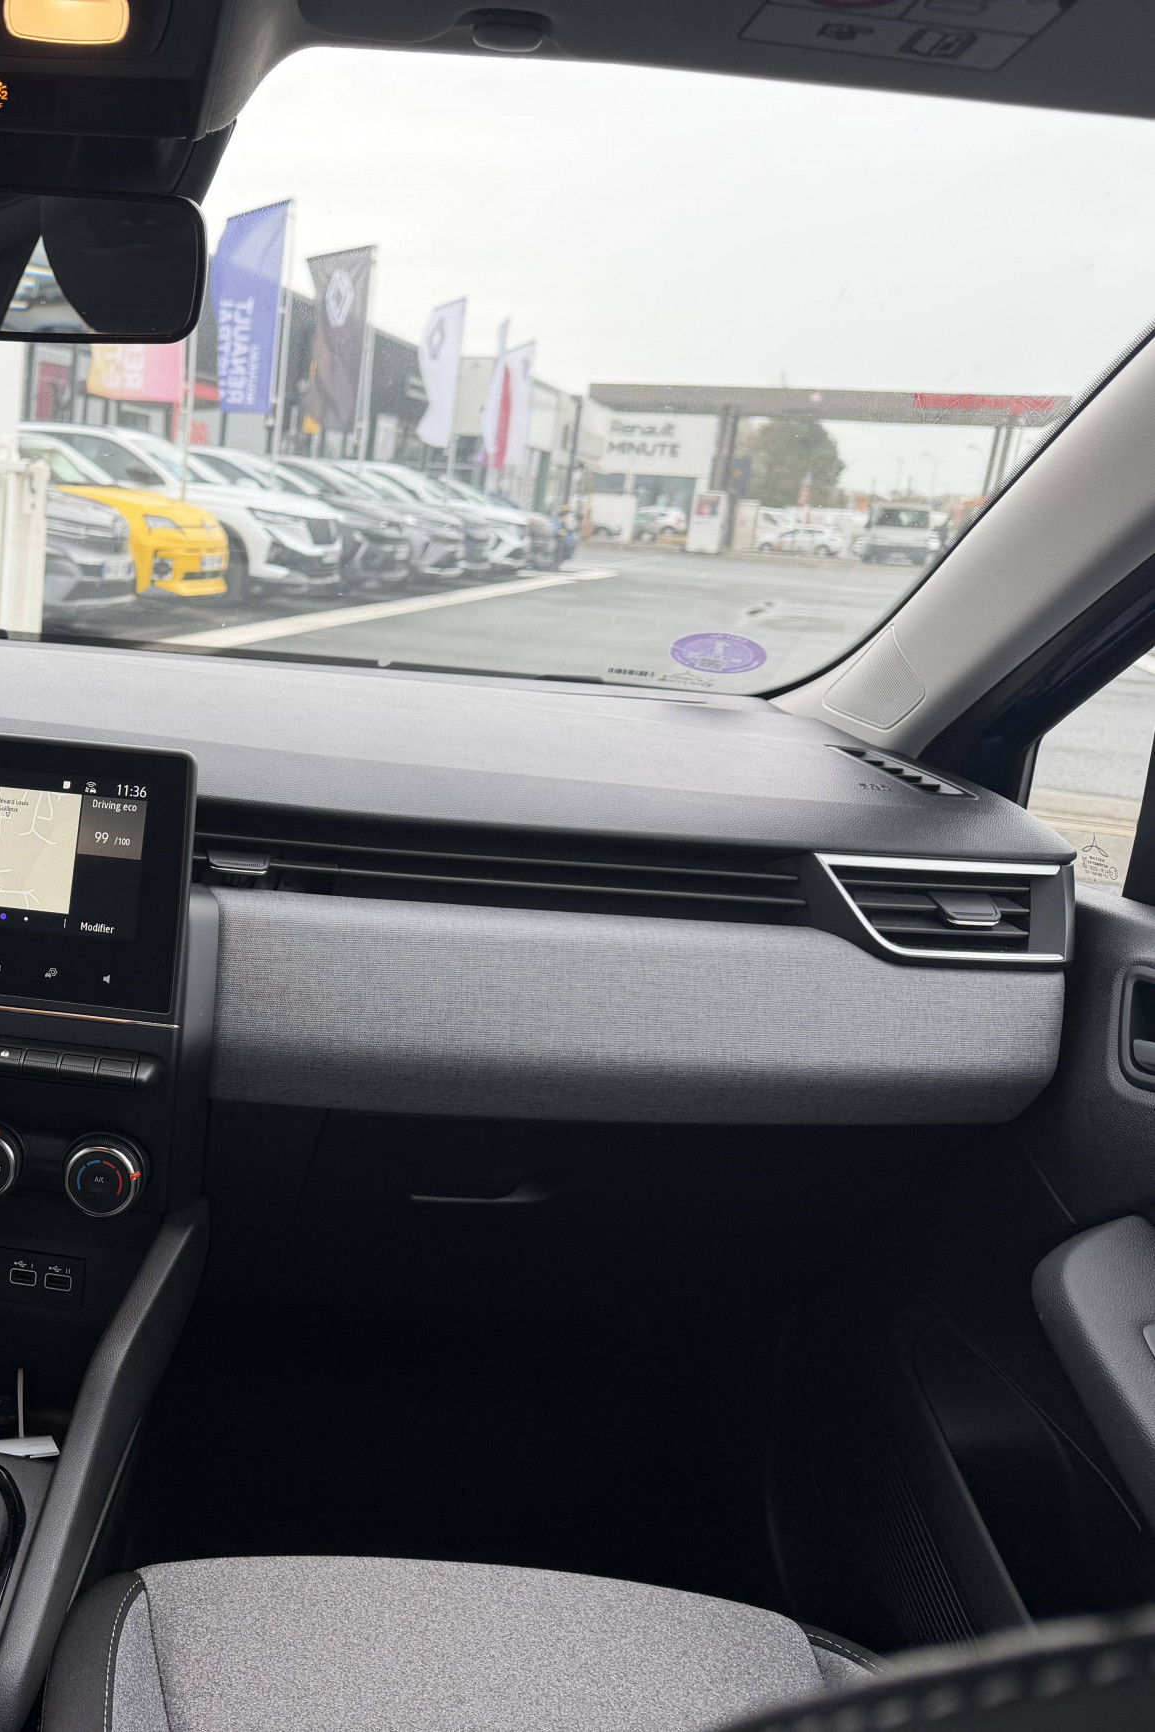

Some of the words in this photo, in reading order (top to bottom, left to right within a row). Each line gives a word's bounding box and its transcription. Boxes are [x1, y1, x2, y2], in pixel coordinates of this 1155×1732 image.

[610, 420, 675, 438] Renault
[607, 441, 680, 458] MINUTE
[116, 783, 147, 798] 11:36
[92, 798, 121, 813] Driving
[122, 803, 137, 812] eco
[94, 831, 110, 844] 99
[113, 836, 131, 846] /100
[80, 921, 115, 934] Modifier
[94, 1176, 105, 1184] A/C
